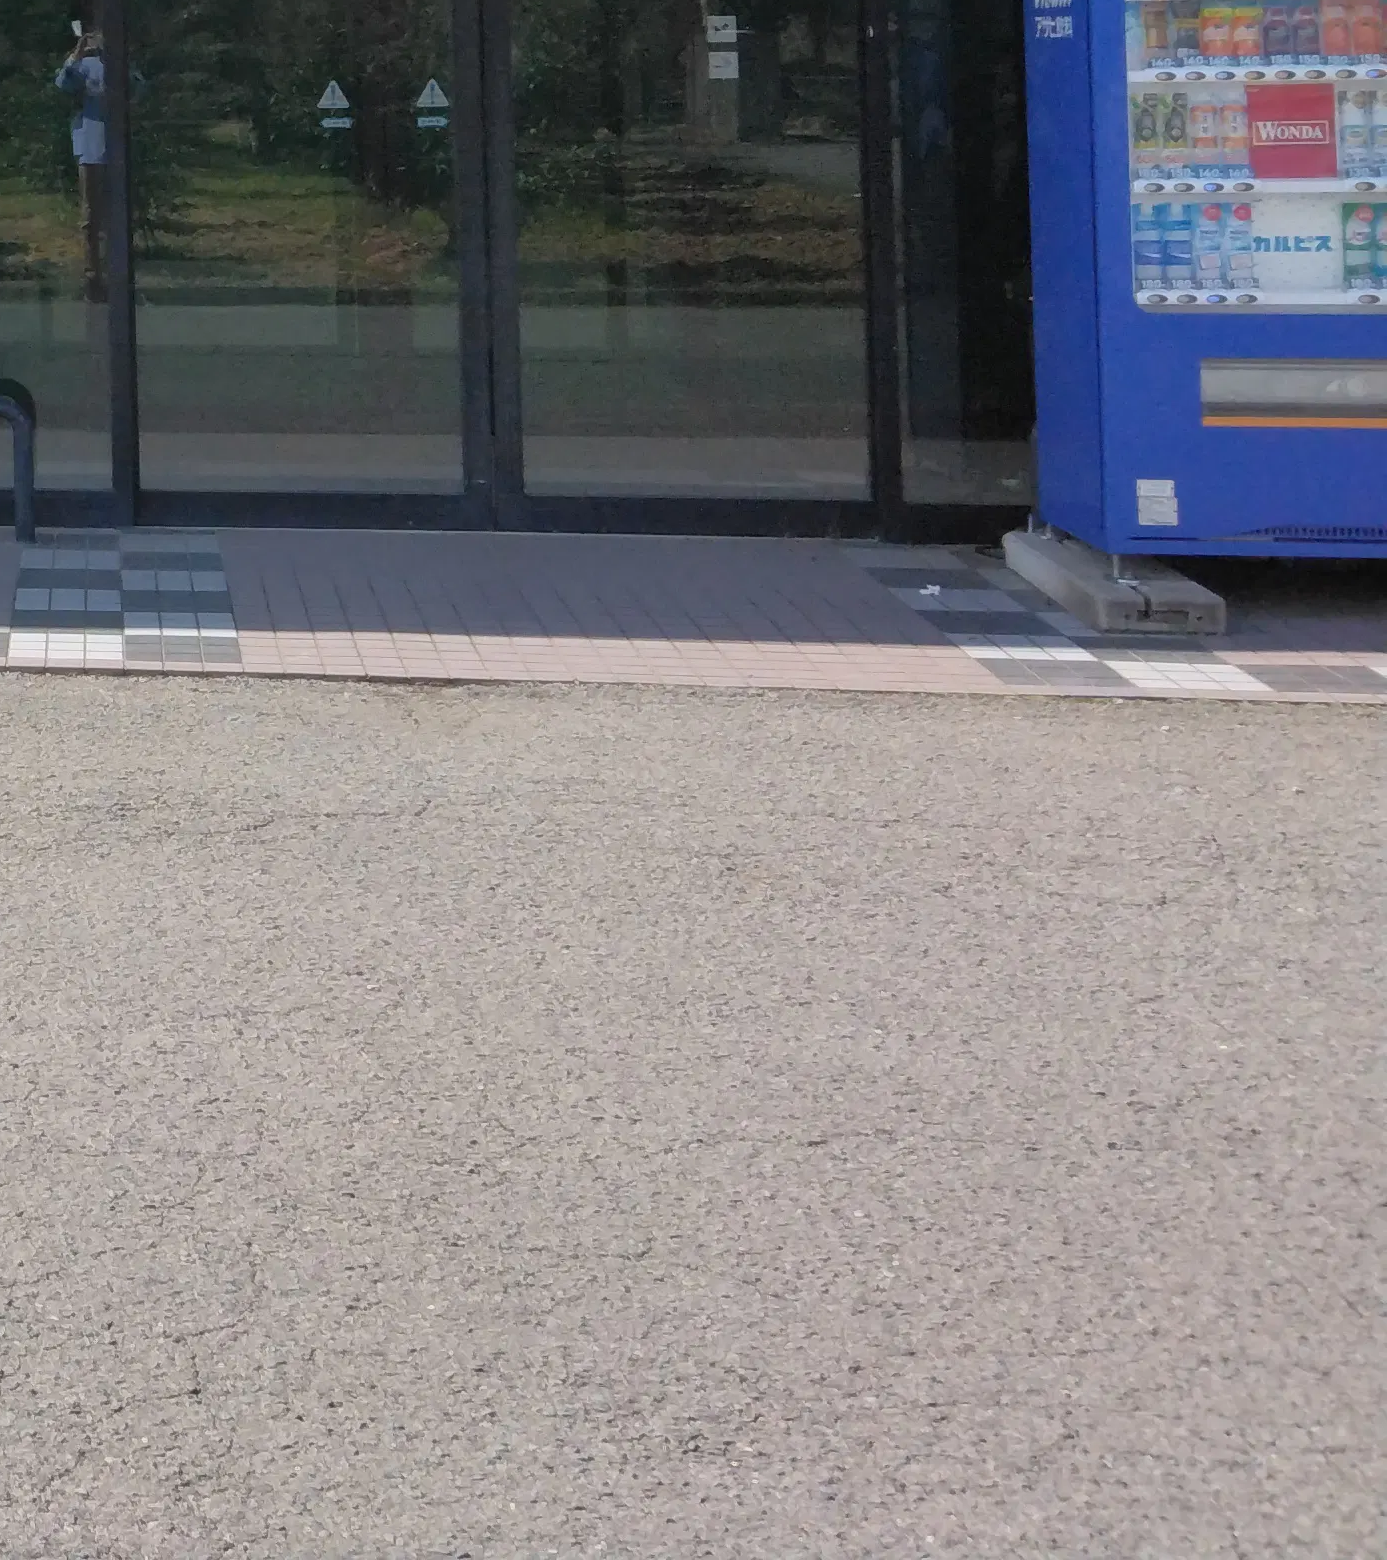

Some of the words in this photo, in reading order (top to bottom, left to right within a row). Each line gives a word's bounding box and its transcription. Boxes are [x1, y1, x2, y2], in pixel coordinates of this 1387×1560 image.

[1256, 121, 1324, 141] WONDA
[1253, 235, 1333, 253] カルピス
